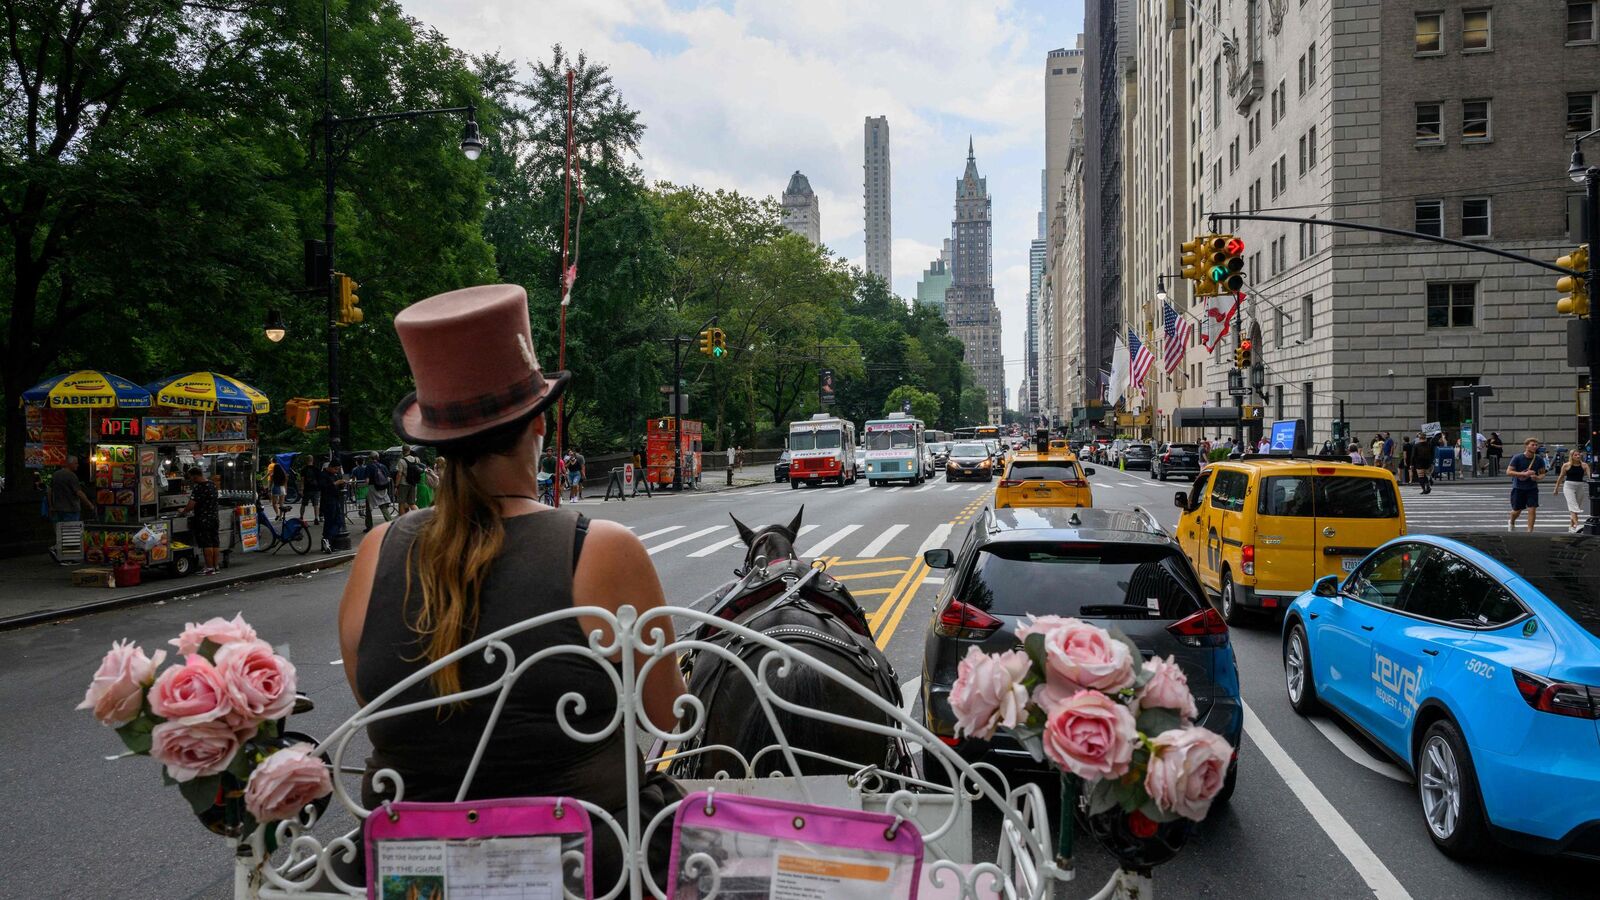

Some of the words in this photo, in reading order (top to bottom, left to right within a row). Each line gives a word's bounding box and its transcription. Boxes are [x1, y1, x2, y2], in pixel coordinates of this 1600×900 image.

[52, 396, 113, 405] SABRETT
[160, 395, 214, 408] SABRETT
[1371, 652, 1424, 710] revel
[1375, 686, 1398, 708] REQUEST
